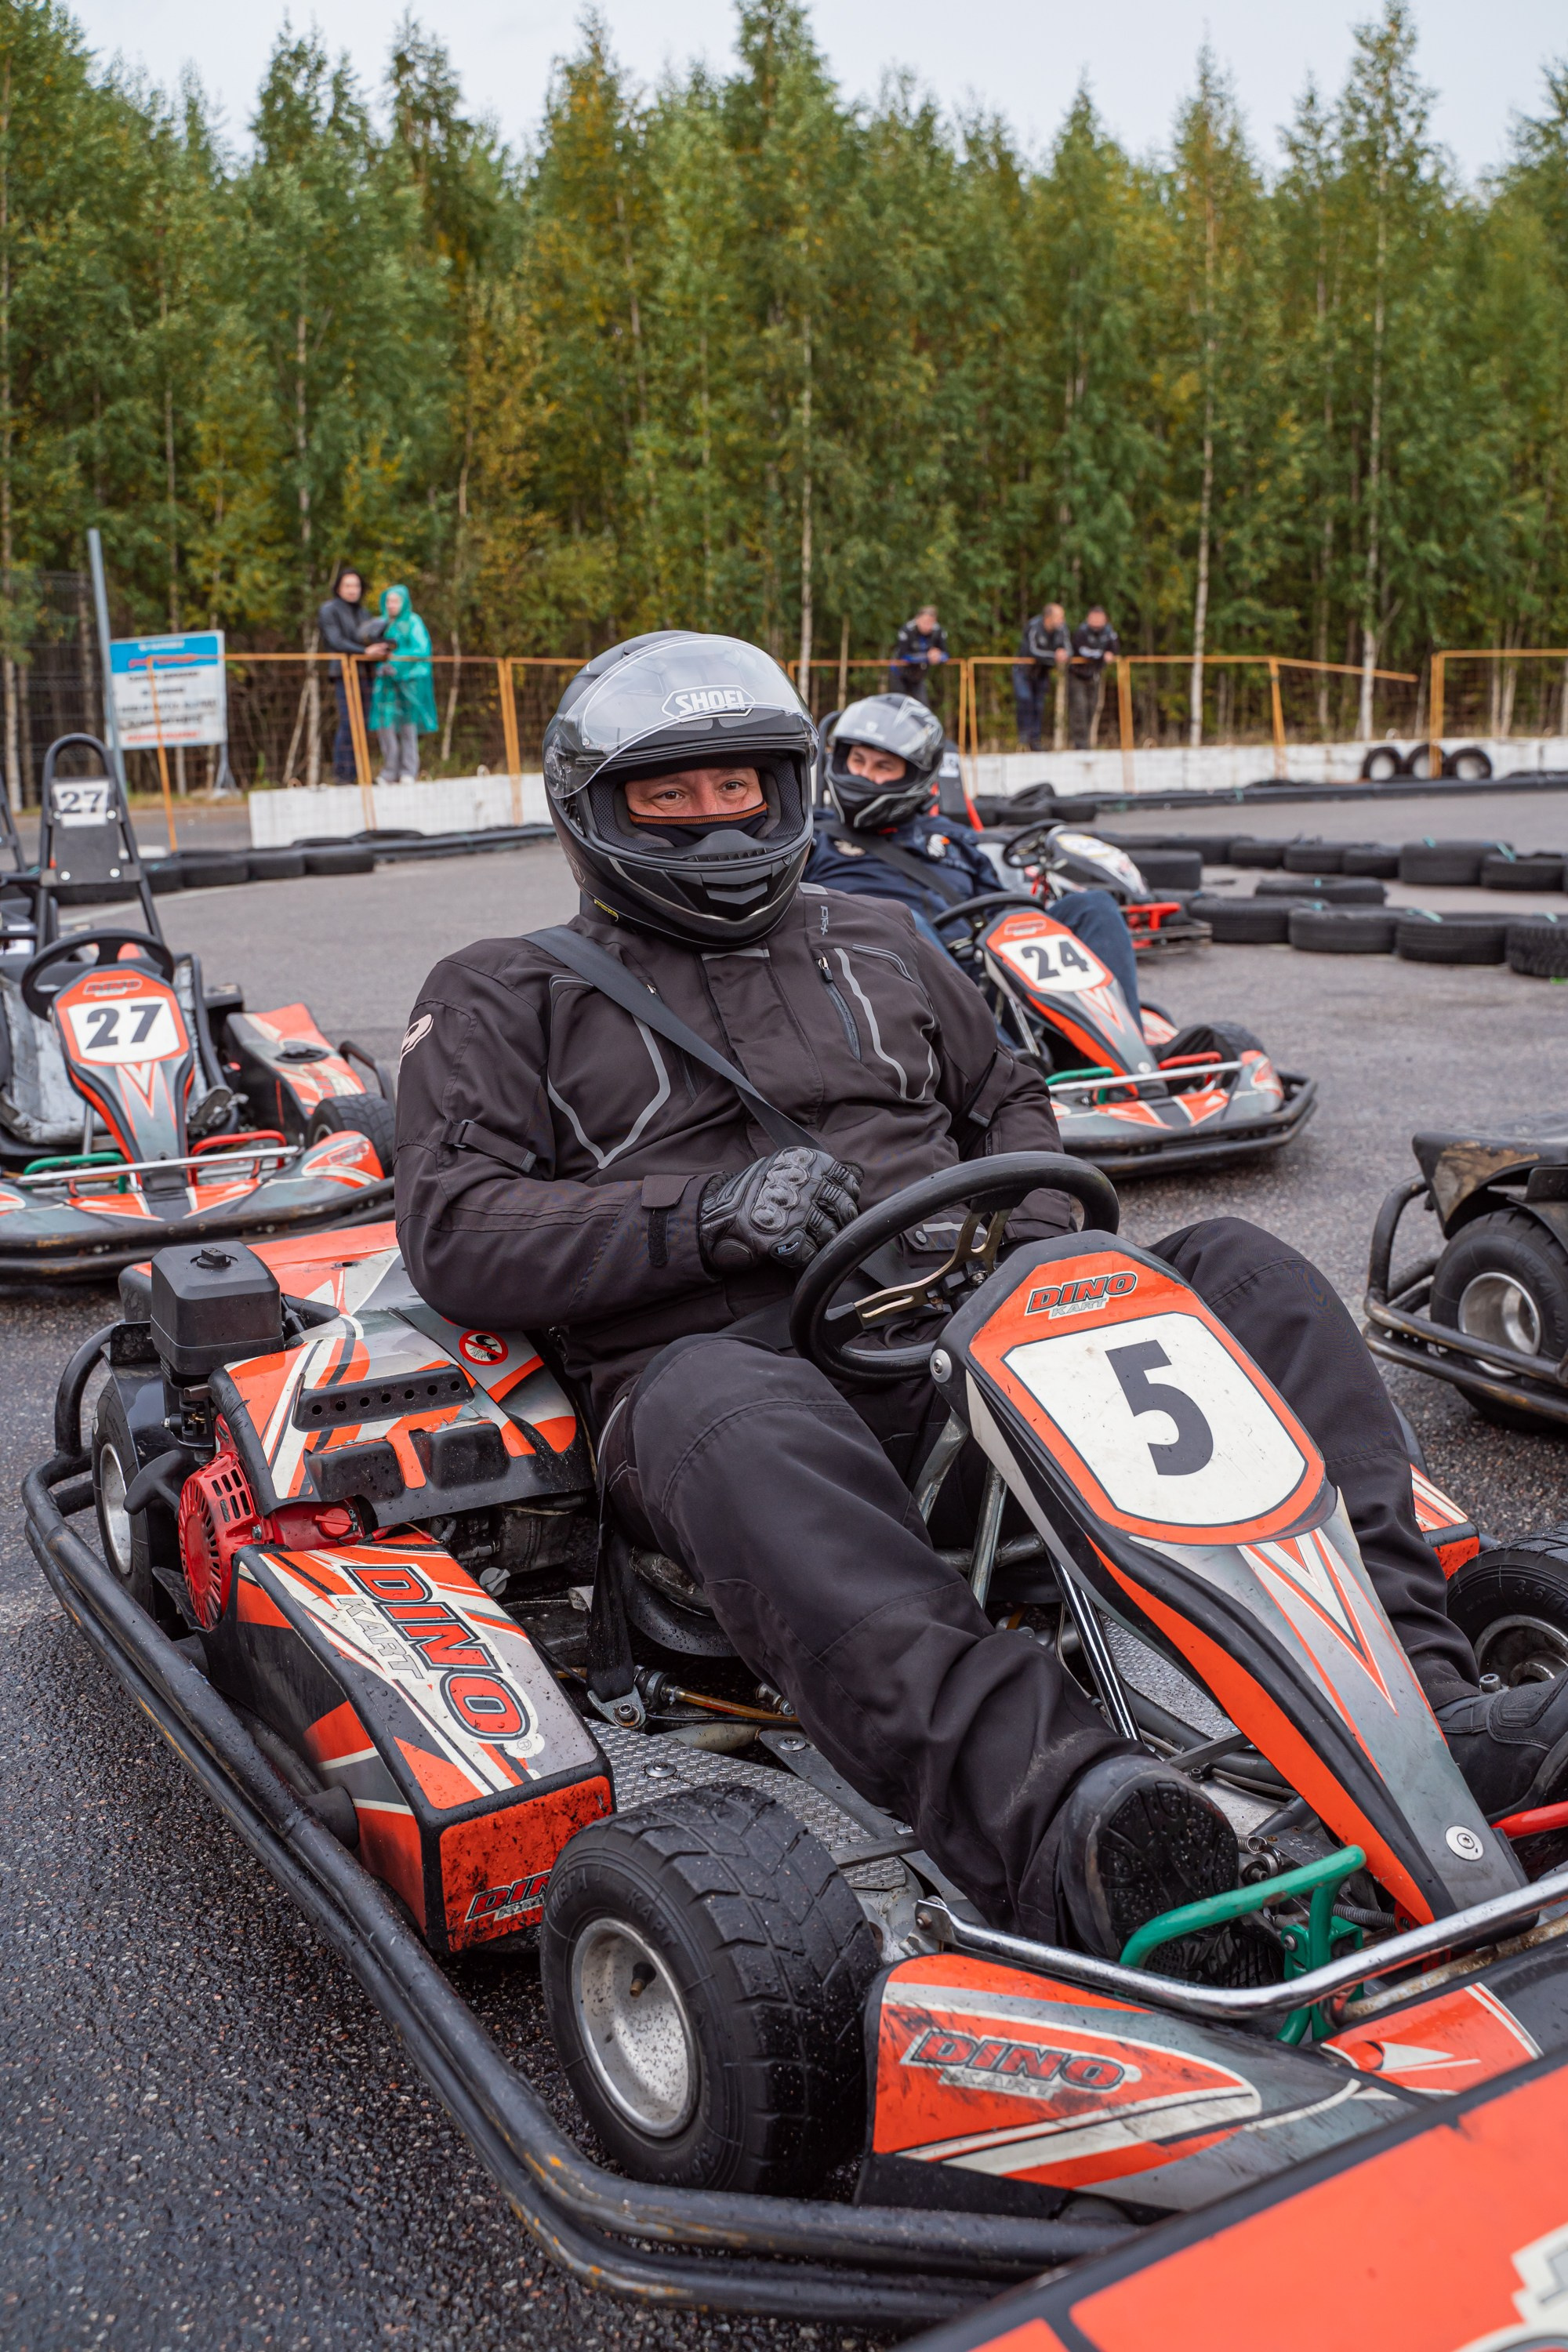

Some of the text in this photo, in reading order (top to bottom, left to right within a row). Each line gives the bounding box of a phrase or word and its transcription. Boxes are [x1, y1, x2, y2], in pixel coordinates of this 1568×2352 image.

[675, 689, 746, 715] SHOEI
[60, 790, 103, 813] 27
[1021, 941, 1089, 981] 24
[85, 1004, 162, 1050] 27
[1026, 1272, 1137, 1313] DINO
[1051, 1298, 1106, 1317] KART
[1105, 1339, 1214, 1475] 5
[336, 1598, 424, 1679] KART
[340, 1565, 532, 1740] DINO
[466, 1871, 552, 1920] DIN
[910, 2029, 1125, 2090] DINO
